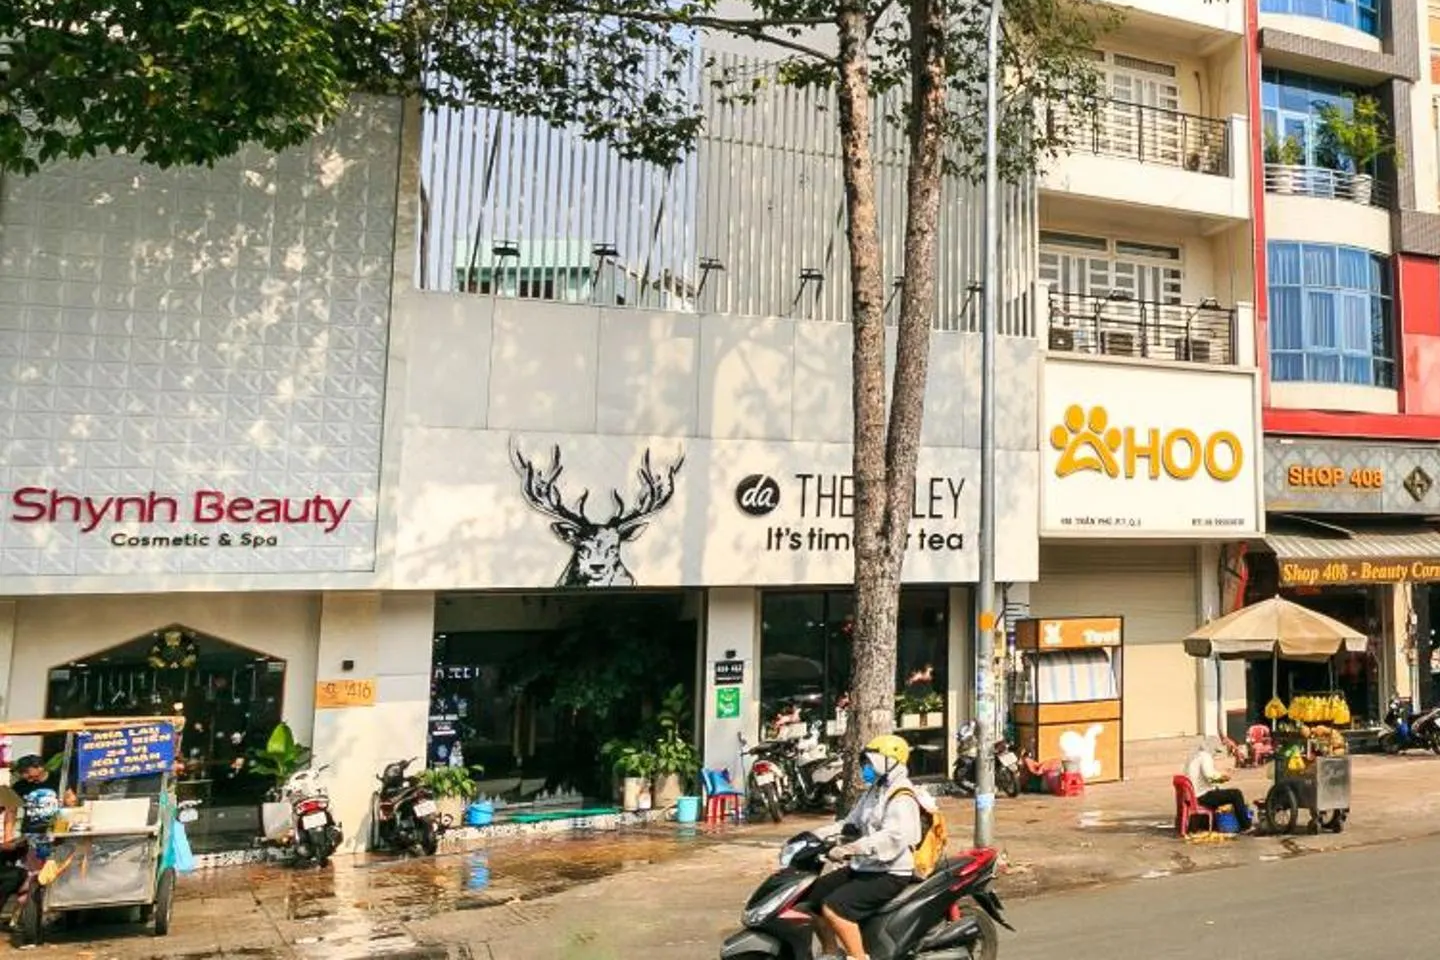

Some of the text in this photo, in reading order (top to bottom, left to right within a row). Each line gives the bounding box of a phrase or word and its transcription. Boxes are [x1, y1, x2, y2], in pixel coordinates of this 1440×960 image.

[1288, 464, 1384, 488] SHOP 408
[795, 474, 855, 519] THE
[12, 487, 352, 533] Shynh Beauty
[110, 533, 278, 548] Cosmetic & Spa
[766, 527, 802, 551] It's
[807, 527, 856, 551] tim
[919, 529, 964, 551] tea
[1283, 563, 1319, 585] Shop
[1323, 561, 1349, 582] 408
[1361, 562, 1408, 582] Beauty
